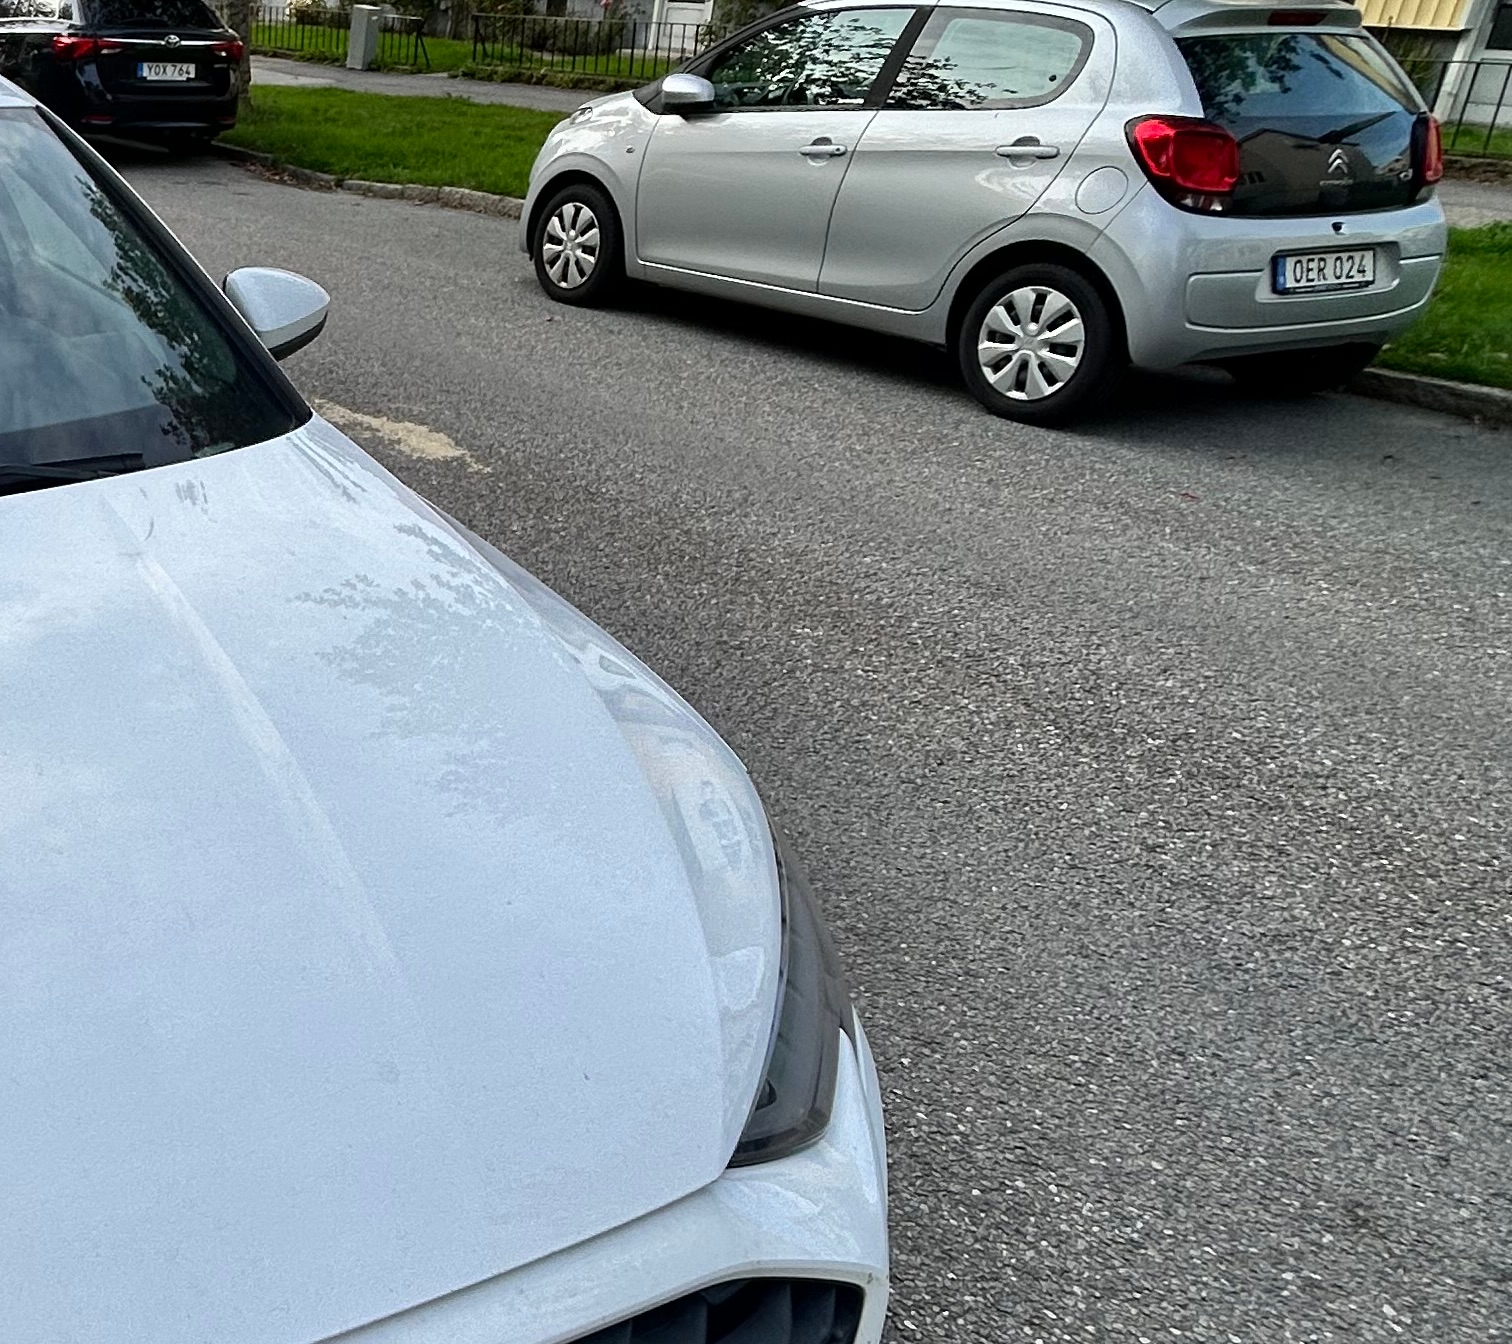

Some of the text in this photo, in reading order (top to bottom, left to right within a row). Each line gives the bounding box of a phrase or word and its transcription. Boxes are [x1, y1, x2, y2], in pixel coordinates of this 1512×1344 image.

[147, 64, 191, 76] YOX 764
[1293, 254, 1367, 284] OER 024
